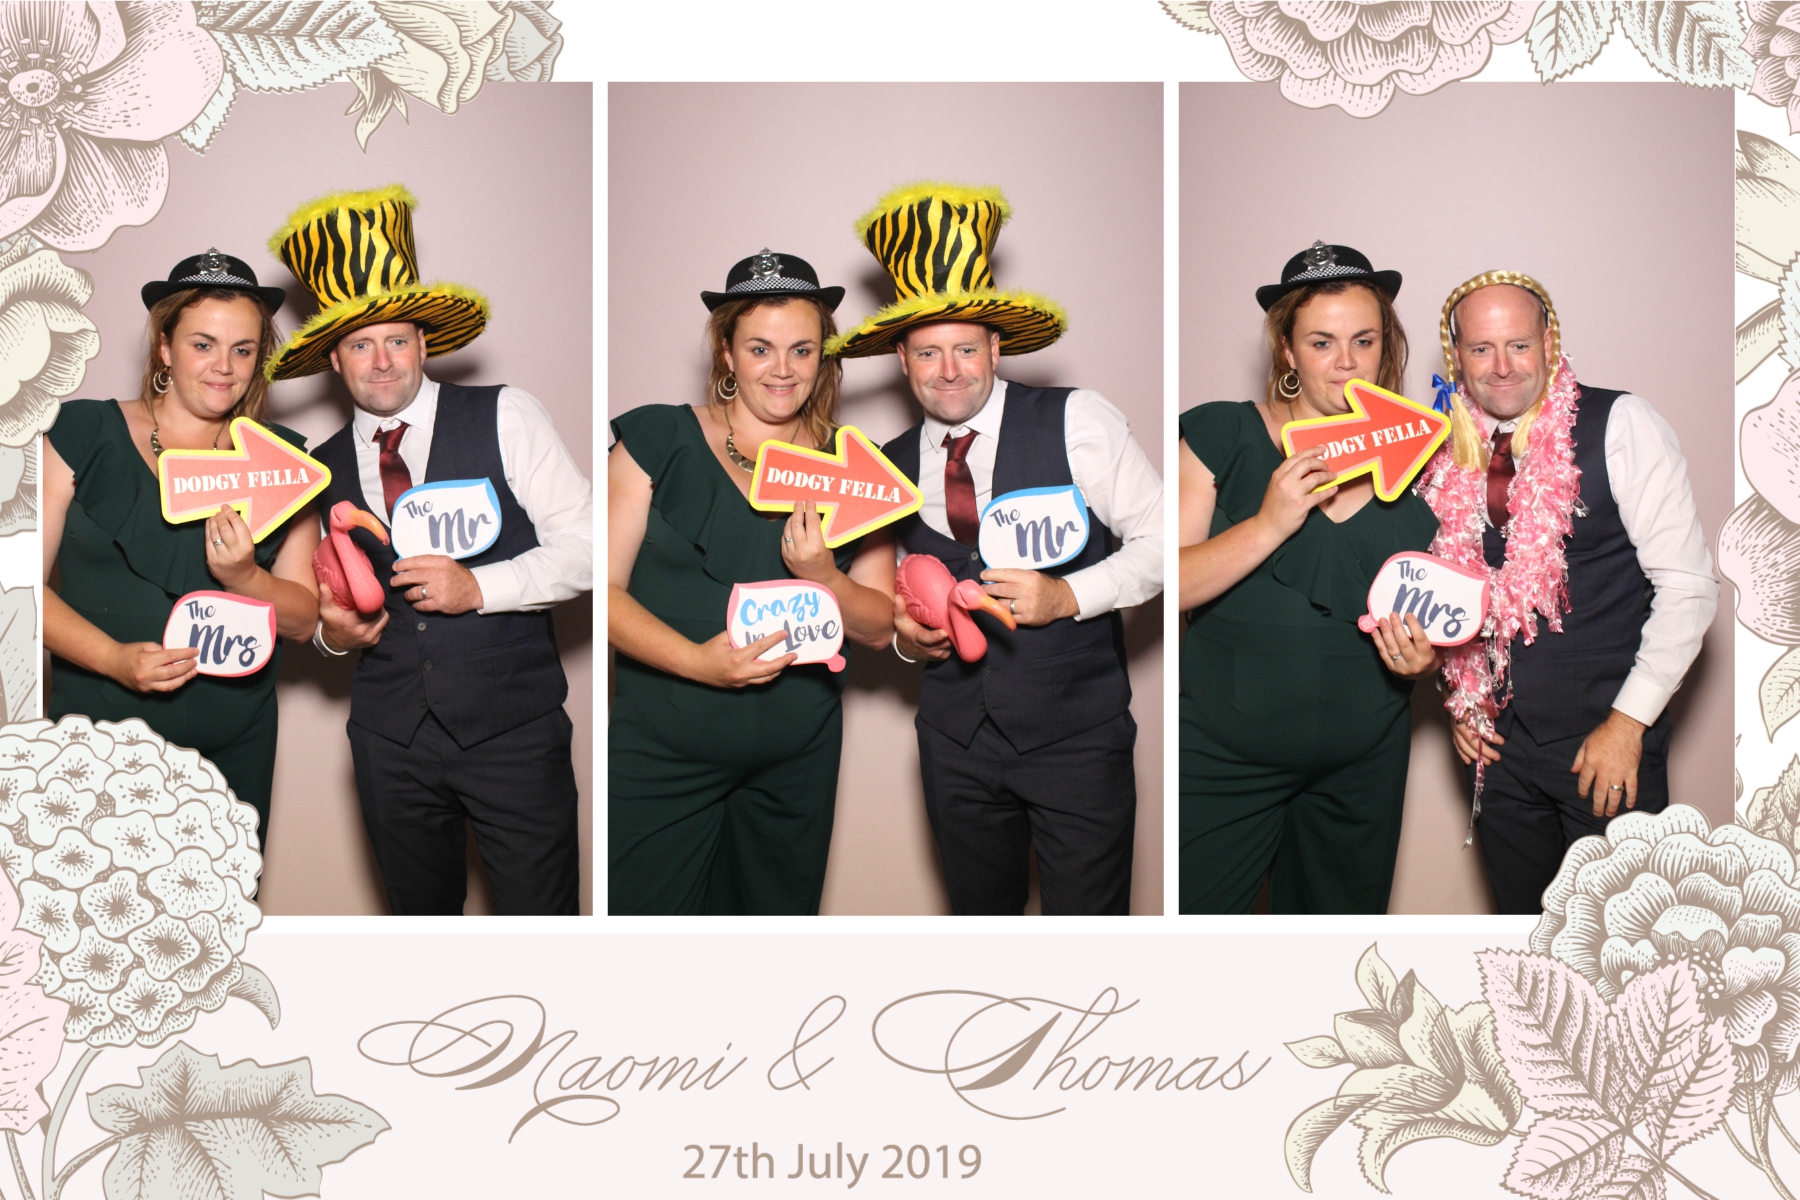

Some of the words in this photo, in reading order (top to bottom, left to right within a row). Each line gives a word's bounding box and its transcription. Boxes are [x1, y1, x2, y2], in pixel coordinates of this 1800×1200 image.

[1316, 434, 1367, 461] ODGY
[1370, 419, 1433, 447] FELLA
[172, 472, 243, 495] DODGY
[247, 467, 311, 488] FELLA
[765, 466, 836, 494] DODGY
[838, 478, 901, 504] FELLA
[402, 499, 434, 519] The
[989, 507, 1022, 528] The
[428, 507, 493, 554] Mr
[1015, 515, 1080, 563] Mr
[1396, 559, 1428, 582] The
[184, 599, 217, 621] The
[739, 591, 821, 627] Crazy
[1391, 583, 1470, 638] Mrs
[188, 623, 262, 668] Mrs
[783, 619, 840, 653] Love
